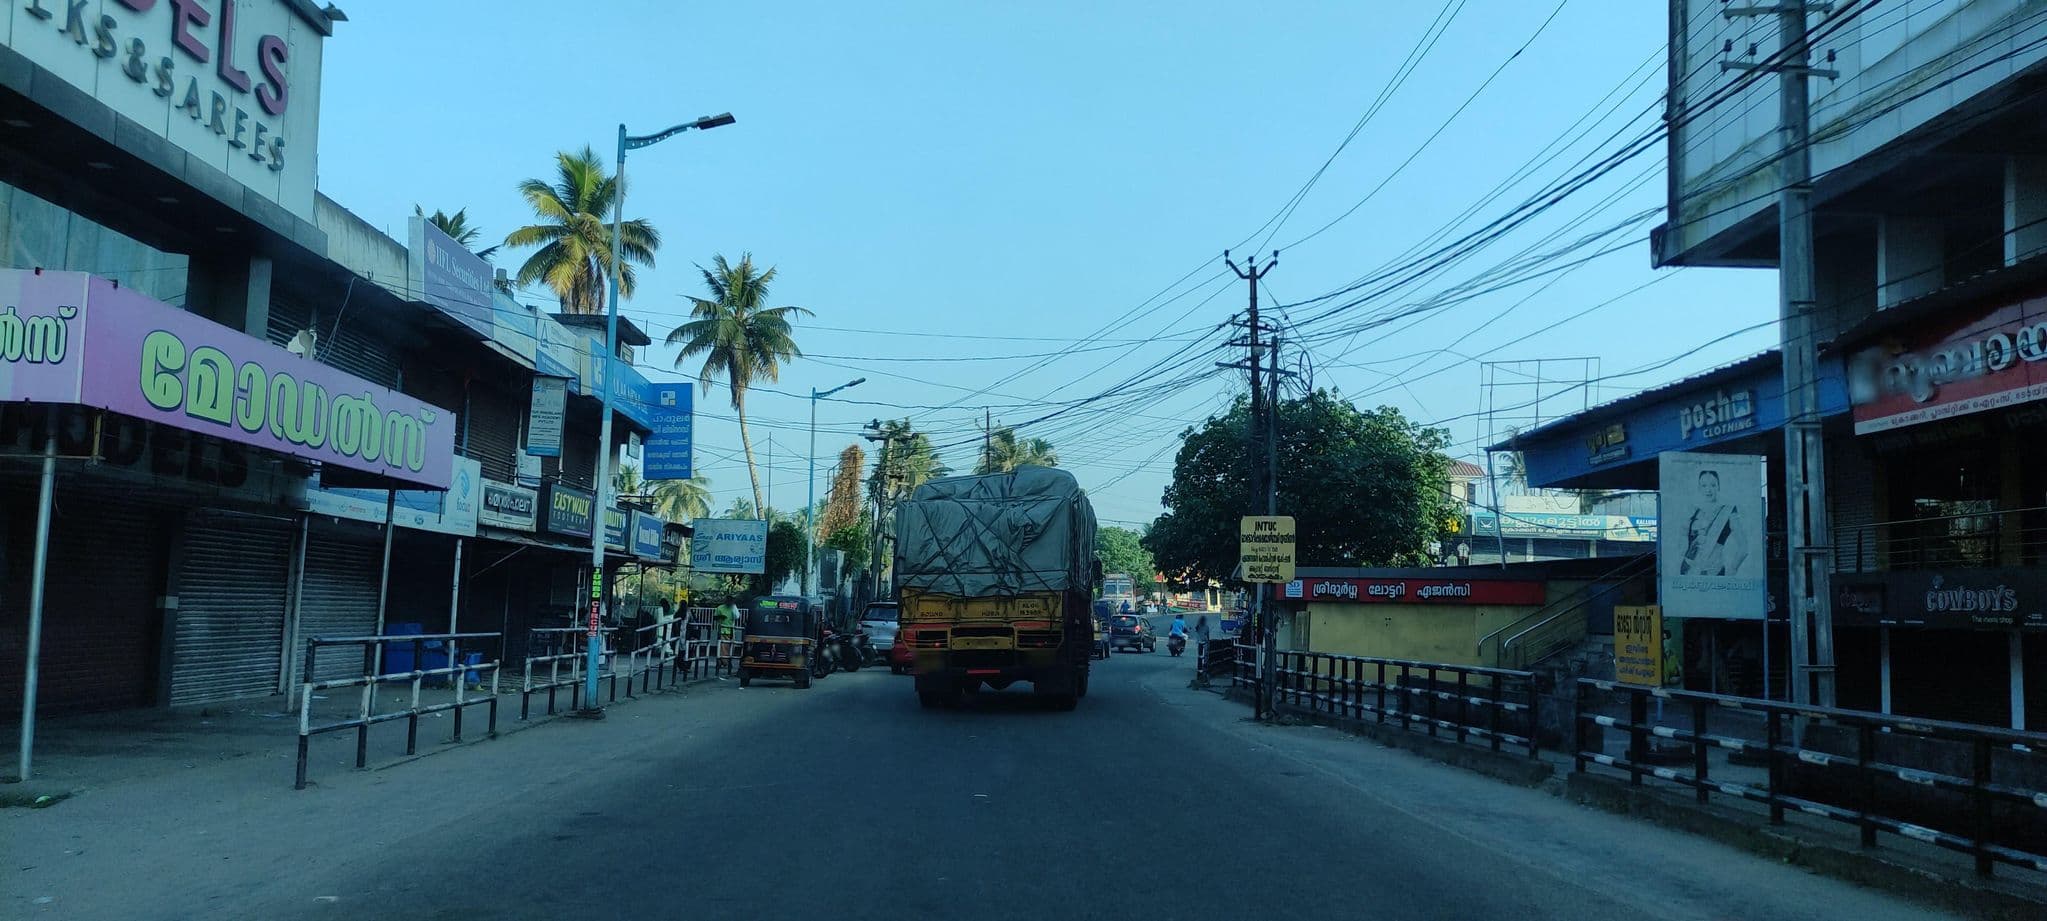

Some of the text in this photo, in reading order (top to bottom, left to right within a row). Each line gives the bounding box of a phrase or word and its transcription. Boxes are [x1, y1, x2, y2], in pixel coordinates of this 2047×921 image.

[115, 0, 289, 116] ELS
[451, 255, 479, 291] Securities
[140, 329, 437, 472] മോഡൽസ്
[1703, 418, 1752, 438] CLOTHING
[716, 532, 763, 542] ARIYAAS
[1255, 521, 1277, 531] INTUC
[1368, 582, 1406, 598] ലോട്ടറി
[1416, 582, 1471, 598] ഏജൻസി
[1926, 585, 2018, 612] COWBOYS
[587, 600, 600, 637] CIRCUS
